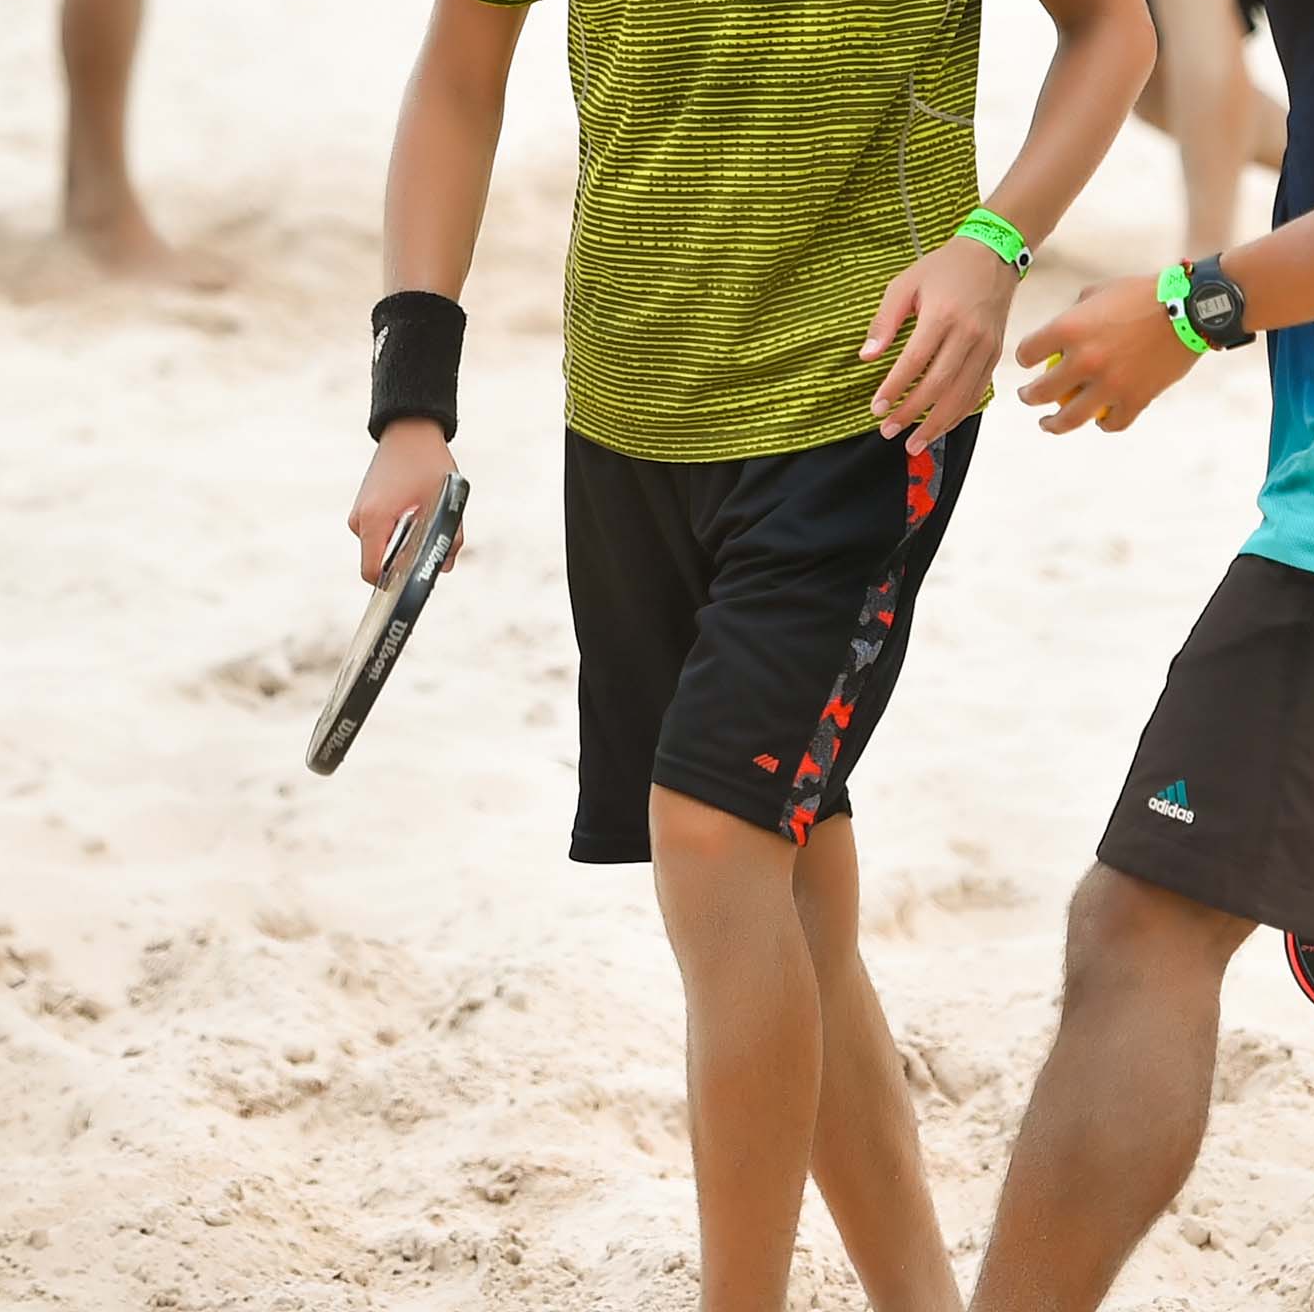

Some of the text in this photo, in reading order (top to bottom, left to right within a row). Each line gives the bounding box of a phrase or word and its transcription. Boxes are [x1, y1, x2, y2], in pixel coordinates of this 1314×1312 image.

[417, 533, 450, 582] Wilson
[368, 619, 408, 682] Wilson
[1148, 796, 1195, 824] adidas
